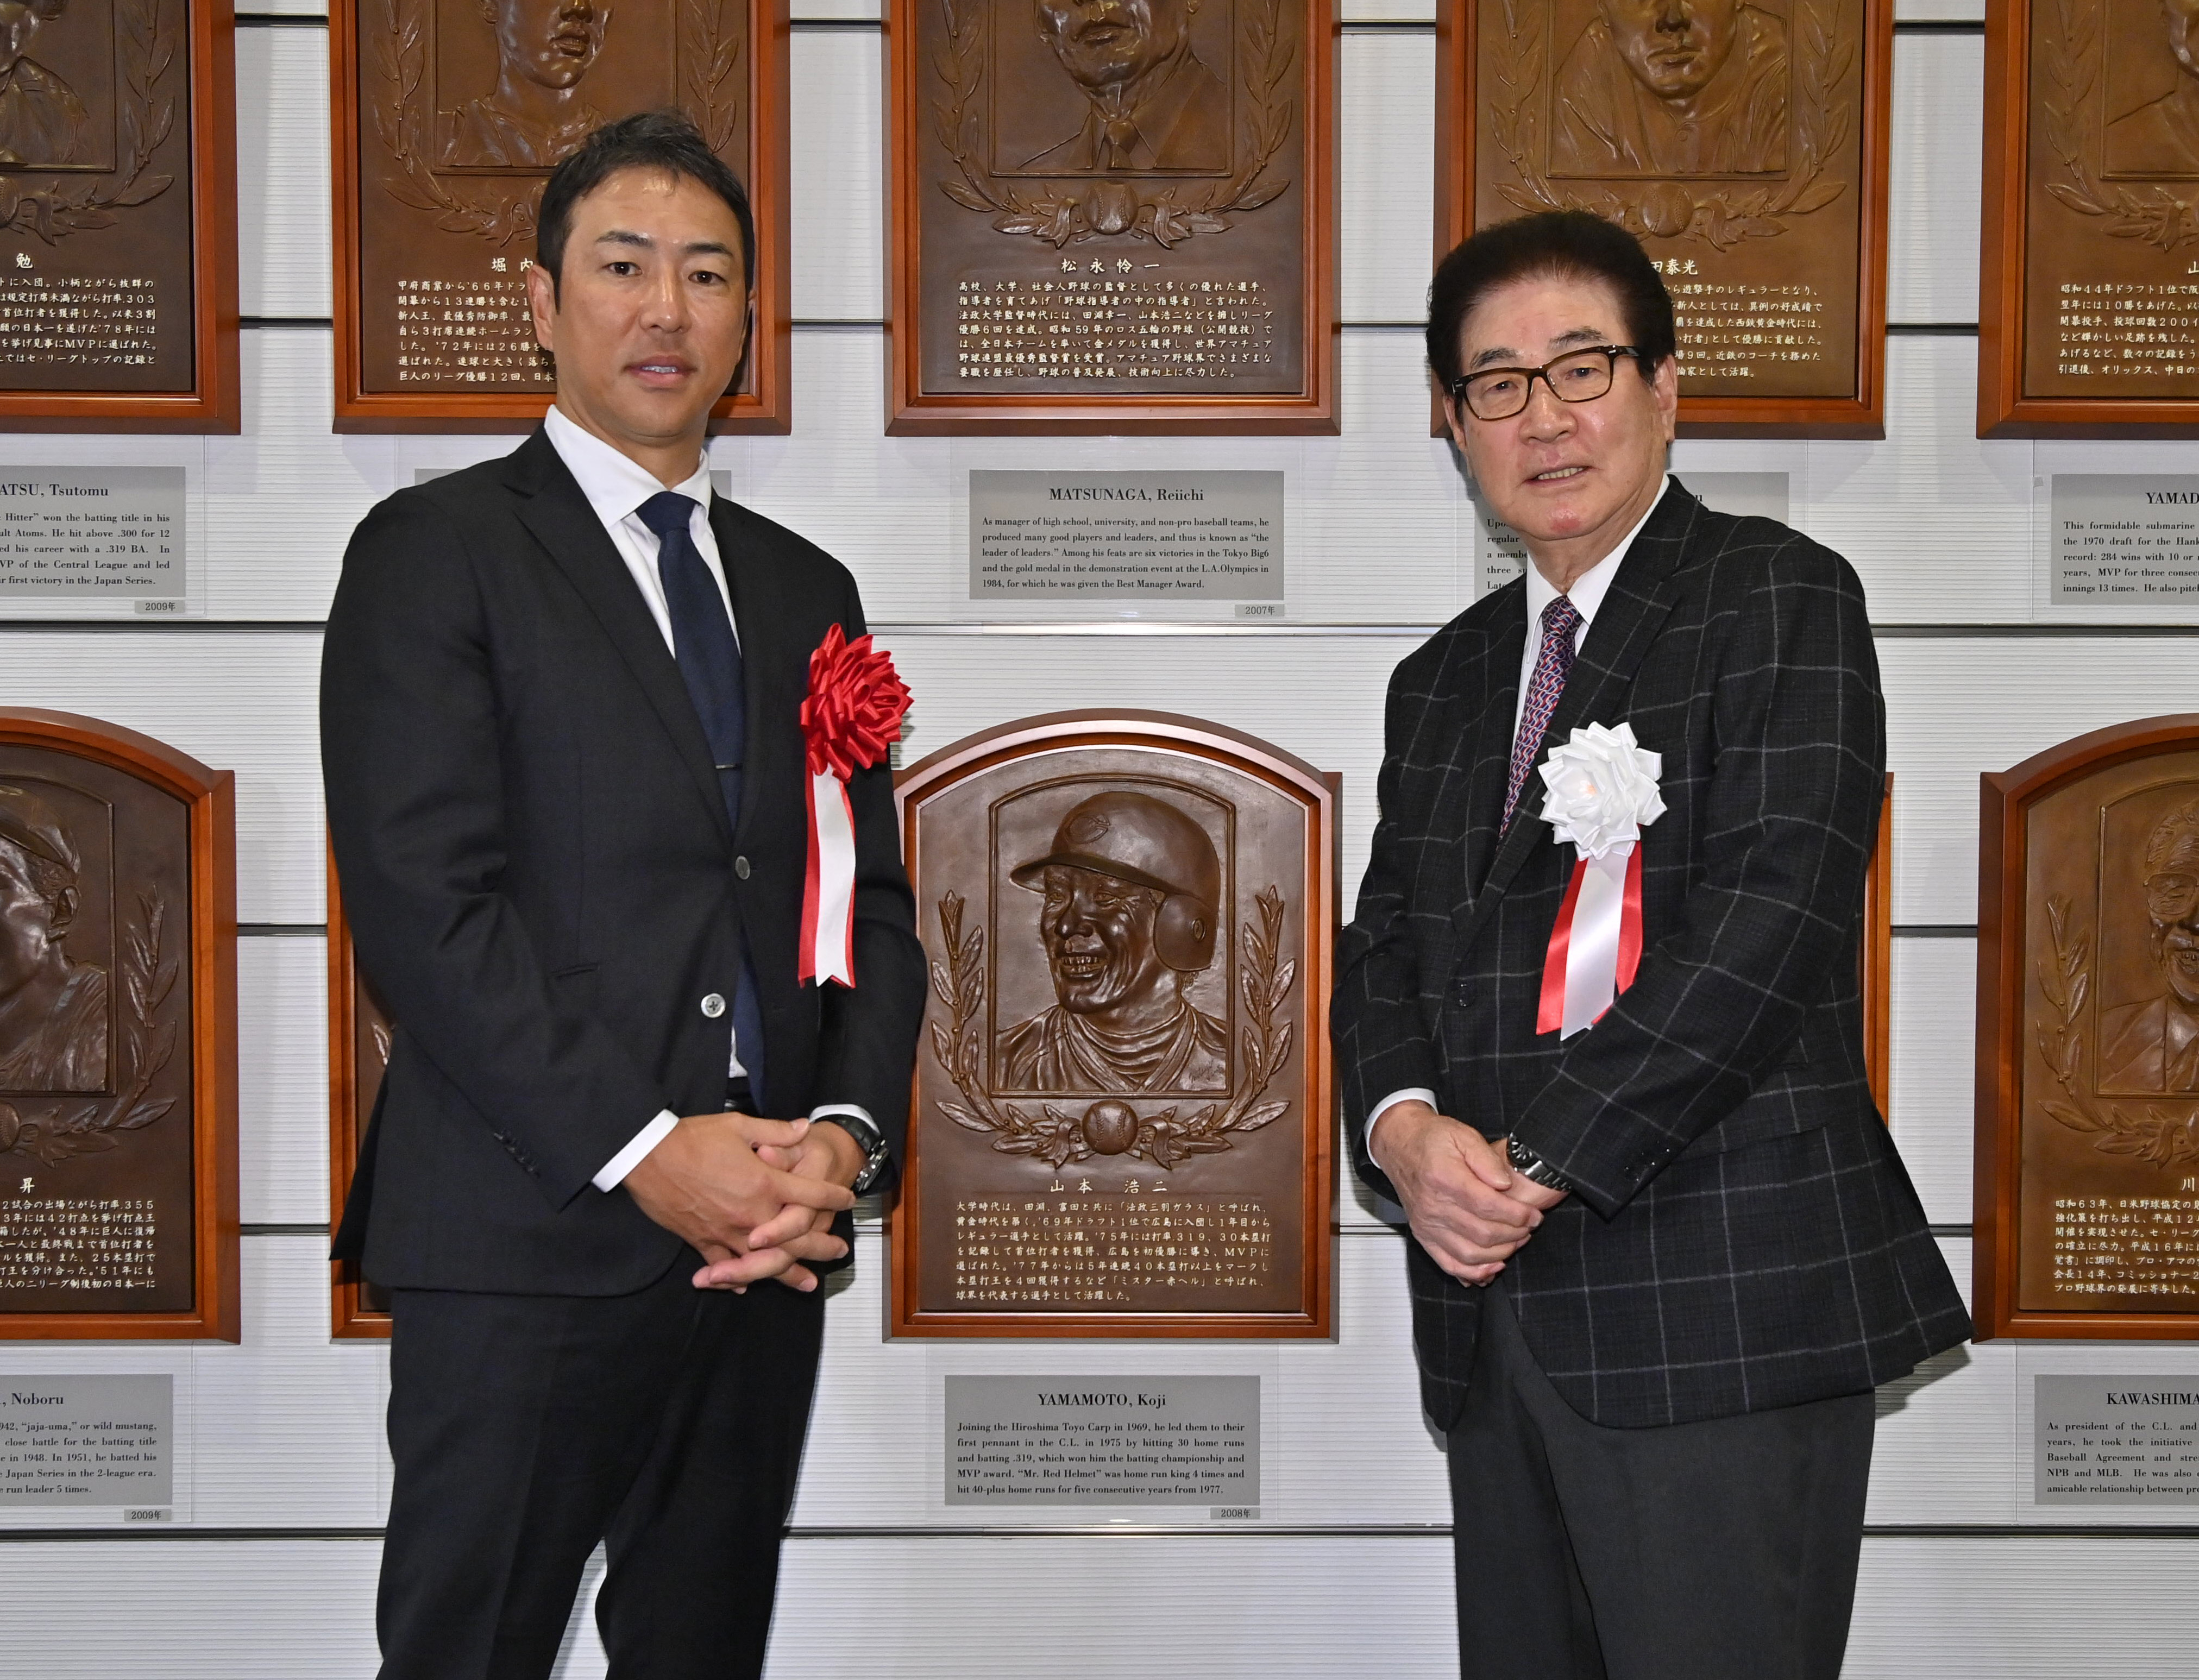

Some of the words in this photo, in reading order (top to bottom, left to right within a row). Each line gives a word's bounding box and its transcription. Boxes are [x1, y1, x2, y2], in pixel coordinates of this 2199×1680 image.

[16, 253, 33, 268] 勉
[49, 484, 108, 496] Tsutomu
[1050, 488, 1152, 502] MATSUNAGA,
[1157, 489, 1203, 500] Reiichi
[85, 513, 117, 524] batting
[1044, 517, 1060, 527] high
[1063, 517, 1091, 526] school,
[1095, 518, 1138, 527] university,
[1195, 518, 1227, 526] baseball
[1260, 518, 1268, 526] he
[983, 532, 1021, 543] produced
[1050, 533, 1069, 543] good
[1073, 533, 1102, 543] players
[1124, 533, 1157, 542] leaders,
[1488, 534, 1520, 545] regular
[1487, 565, 1511, 574] three
[31, 576, 62, 586] victory
[95, 576, 122, 586] Japan
[984, 580, 1004, 588] 1984,
[1022, 579, 1045, 587] which
[1078, 580, 1098, 589] given
[1138, 580, 1172, 590] Manager
[1176, 580, 1204, 588] Award.
[146, 602, 175, 611] 2009年
[1246, 606, 1275, 615] 2007年
[20, 1178, 34, 1193] 昇
[1051, 1178, 1167, 1193] 山本浩二
[2182, 1178, 2194, 1191] 川
[12, 1393, 63, 1404] Noboru
[1038, 1394, 1132, 1407] YAMAMOTO,
[1139, 1394, 1165, 1408] Koji
[958, 1423, 990, 1432] Joining
[994, 1423, 1008, 1431] the
[1012, 1423, 1058, 1431] Hiroshima
[1062, 1423, 1084, 1433] Toyo
[1088, 1423, 1110, 1433] Carp
[1128, 1423, 1151, 1431] 1969,
[1155, 1423, 1165, 1431] he
[1168, 1423, 1181, 1431] led
[1186, 1423, 1207, 1431] them
[2066, 1422, 2108, 1432] president
[2152, 1422, 2172, 1430] C.L.
[2180, 1422, 2196, 1430] and
[5, 1438, 27, 1446] close
[83, 1437, 97, 1445] the
[102, 1437, 134, 1447] batting
[982, 1440, 1019, 1449] pennant
[1059, 1438, 1079, 1446] C.L.
[1127, 1438, 1137, 1449] by
[1144, 1438, 1173, 1448] hitting
[958, 1454, 973, 1462] and
[978, 1454, 1009, 1464] batting
[1013, 1454, 1035, 1463] .319,
[1090, 1454, 1106, 1462] him
[1110, 1454, 1123, 1462] the
[1127, 1454, 1158, 1464] batting
[1162, 1454, 1224, 1464] championship
[131, 1511, 161, 1520] 2009年
[1221, 1508, 1251, 1519] 2008年
